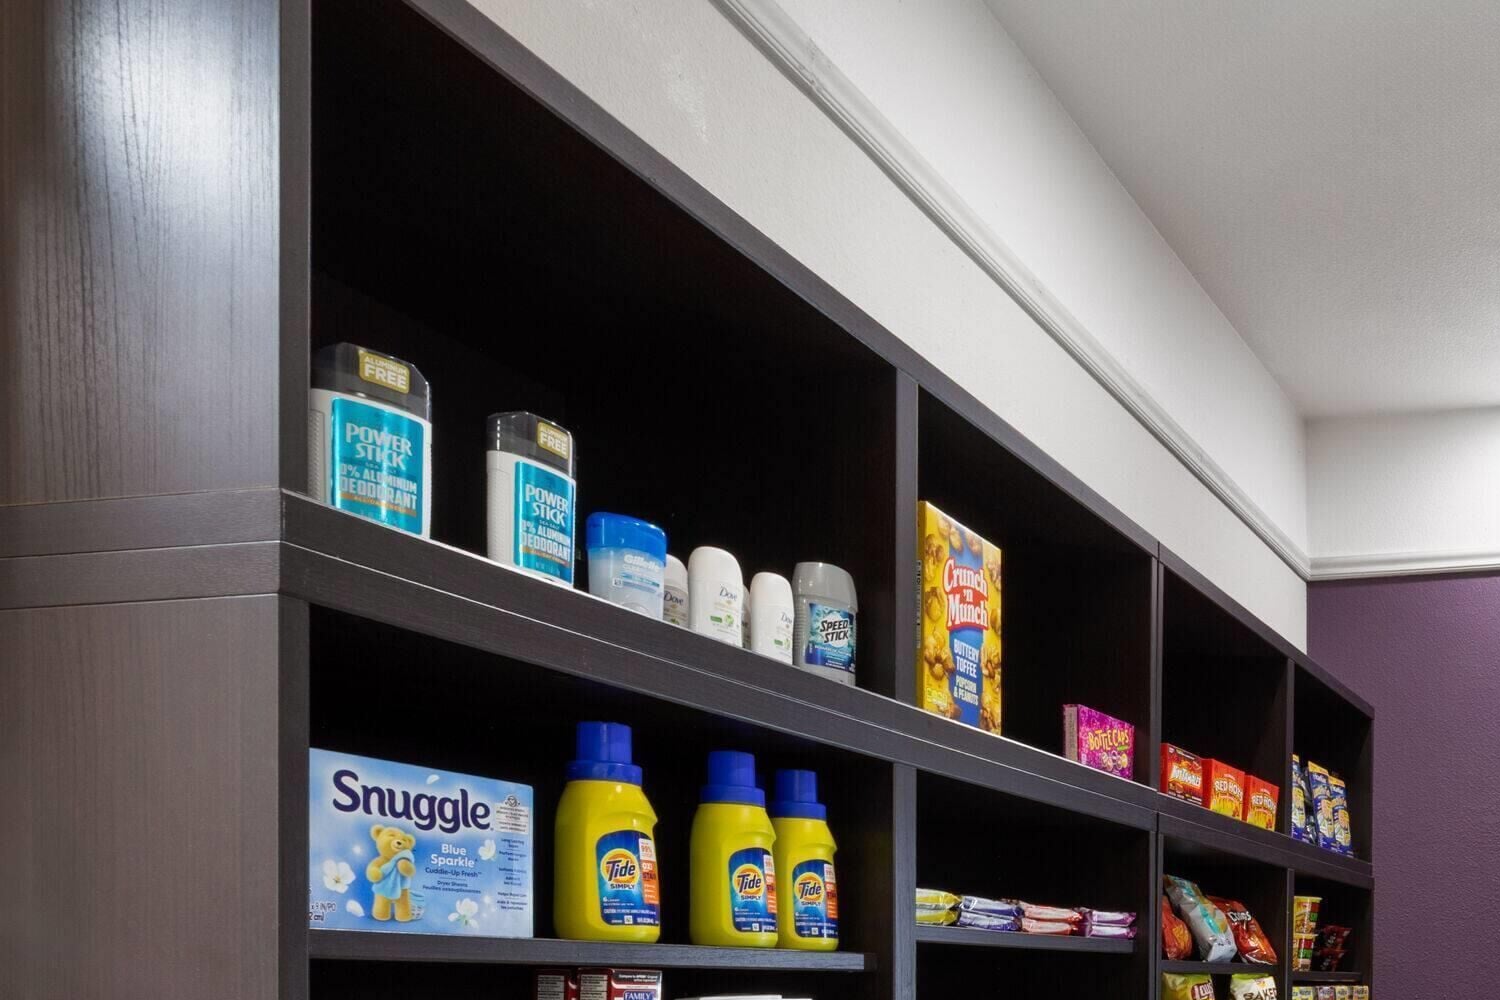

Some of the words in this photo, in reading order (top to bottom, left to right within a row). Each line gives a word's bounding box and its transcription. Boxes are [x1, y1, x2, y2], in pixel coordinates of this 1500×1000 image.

[364, 356, 408, 376] ALUMINUM
[365, 364, 407, 390] FREE
[345, 423, 413, 456] POWER
[540, 433, 567, 455] FREE
[355, 442, 405, 470] STICK
[363, 467, 417, 494] ALUMINUM
[340, 476, 417, 510] DEODORANT
[525, 483, 570, 514] POWER
[533, 502, 566, 527] STICK
[522, 534, 571, 562] DEODORANT
[624, 554, 661, 572] Gillette
[944, 559, 988, 596] Crunch
[664, 590, 683, 605] Dove
[719, 585, 737, 601] Dove
[947, 594, 989, 631] Munch
[820, 619, 848, 633] SPEED
[824, 630, 849, 643] STICK
[954, 639, 979, 663] BUTTERY
[956, 656, 977, 678] TOFFEE
[1214, 780, 1227, 793] RED
[332, 769, 491, 834] Snuggle
[1251, 794, 1263, 806] RED
[441, 843, 467, 857] Blue
[430, 854, 475, 869] Sparkle
[606, 859, 636, 883] Tide
[425, 867, 461, 878] Cuddle-Up
[736, 874, 761, 892] Tide
[610, 883, 636, 891] SIMPLY
[799, 882, 821, 899] Tide
[624, 992, 652, 1000] FAMILY
